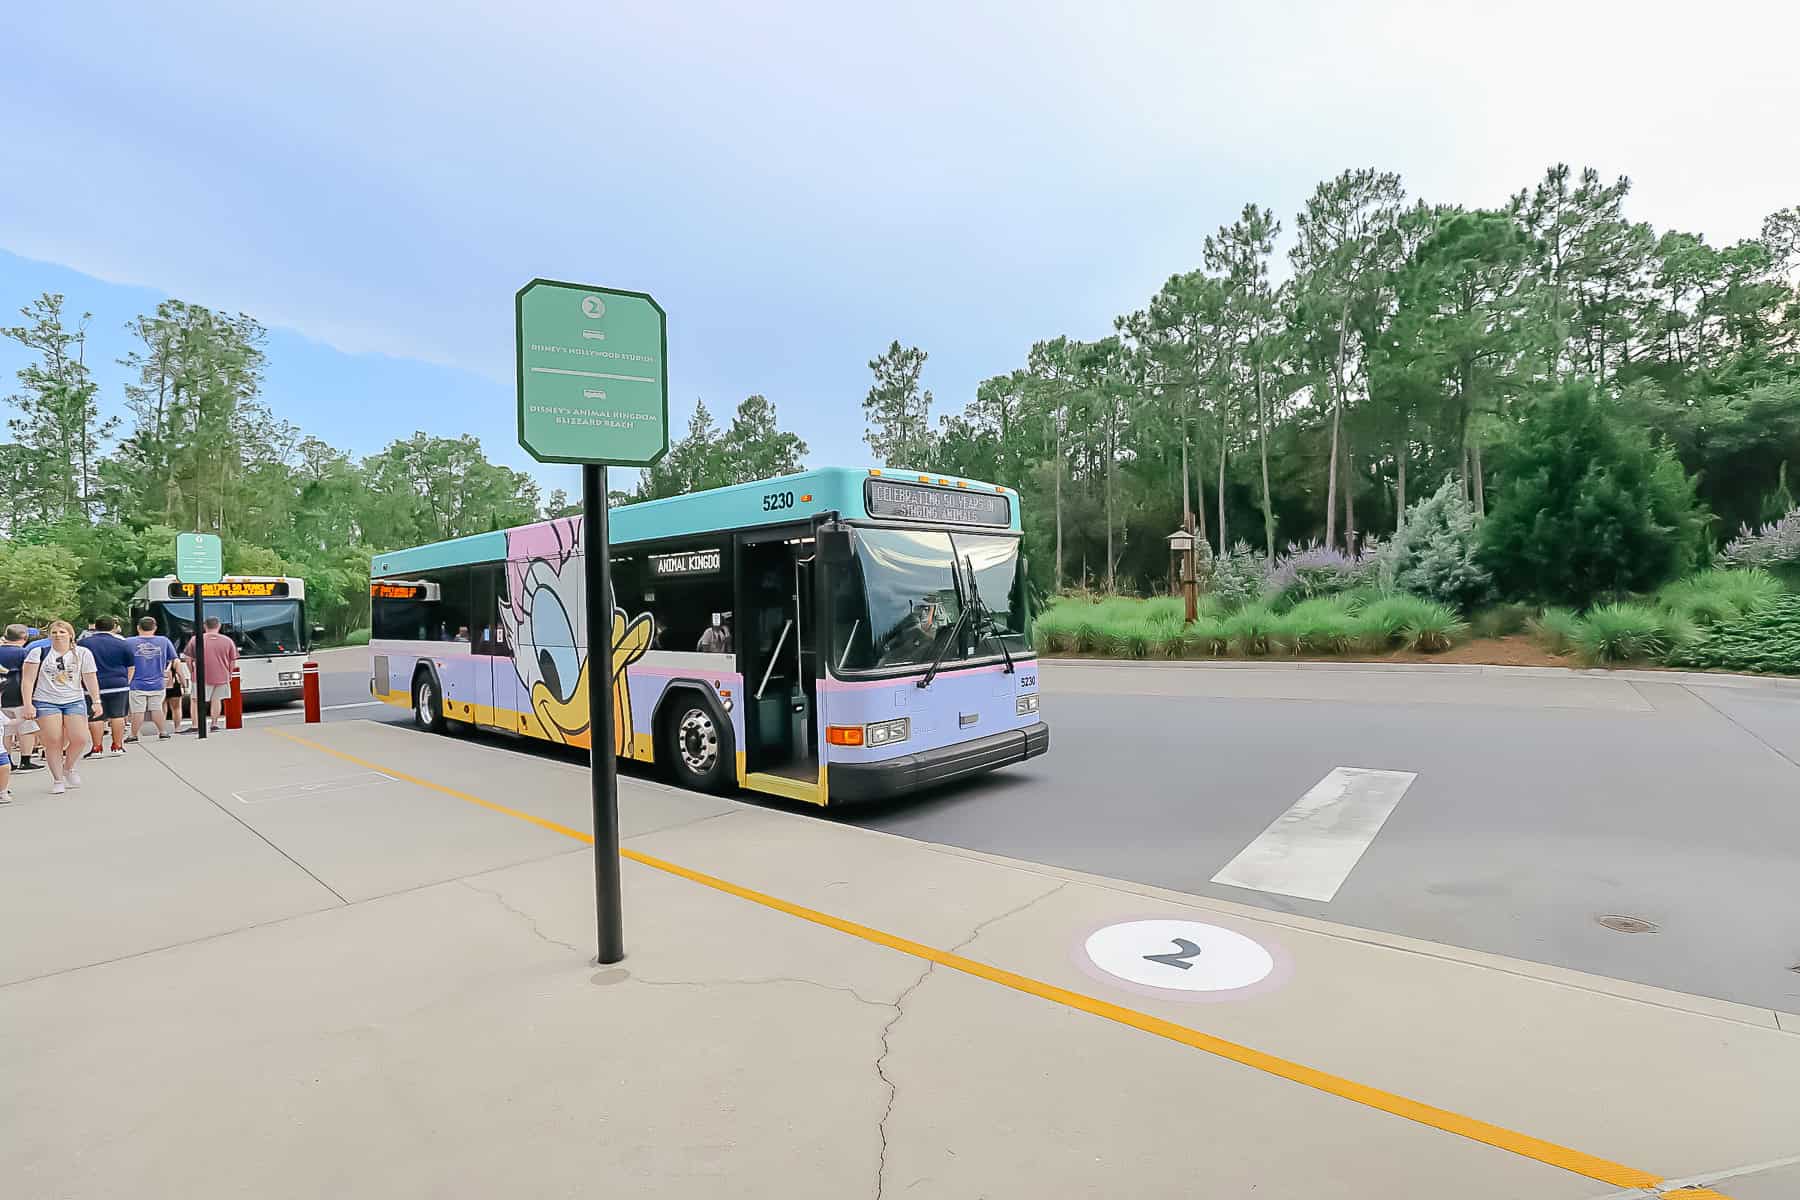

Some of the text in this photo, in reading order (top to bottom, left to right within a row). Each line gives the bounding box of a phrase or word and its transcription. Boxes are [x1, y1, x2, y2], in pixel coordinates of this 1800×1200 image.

[587, 300, 600, 314] 2
[569, 347, 621, 360] HOLLYWOOD
[529, 405, 657, 421] DISNEY'S ANIMAL KINGDOM
[555, 416, 634, 429] BLIZZARD BEACH
[763, 491, 794, 511] 5230
[877, 486, 940, 506] CELEBRATING
[658, 556, 687, 573] ANIMAL
[1021, 675, 1036, 688] 5230
[1142, 938, 1202, 970] 2
